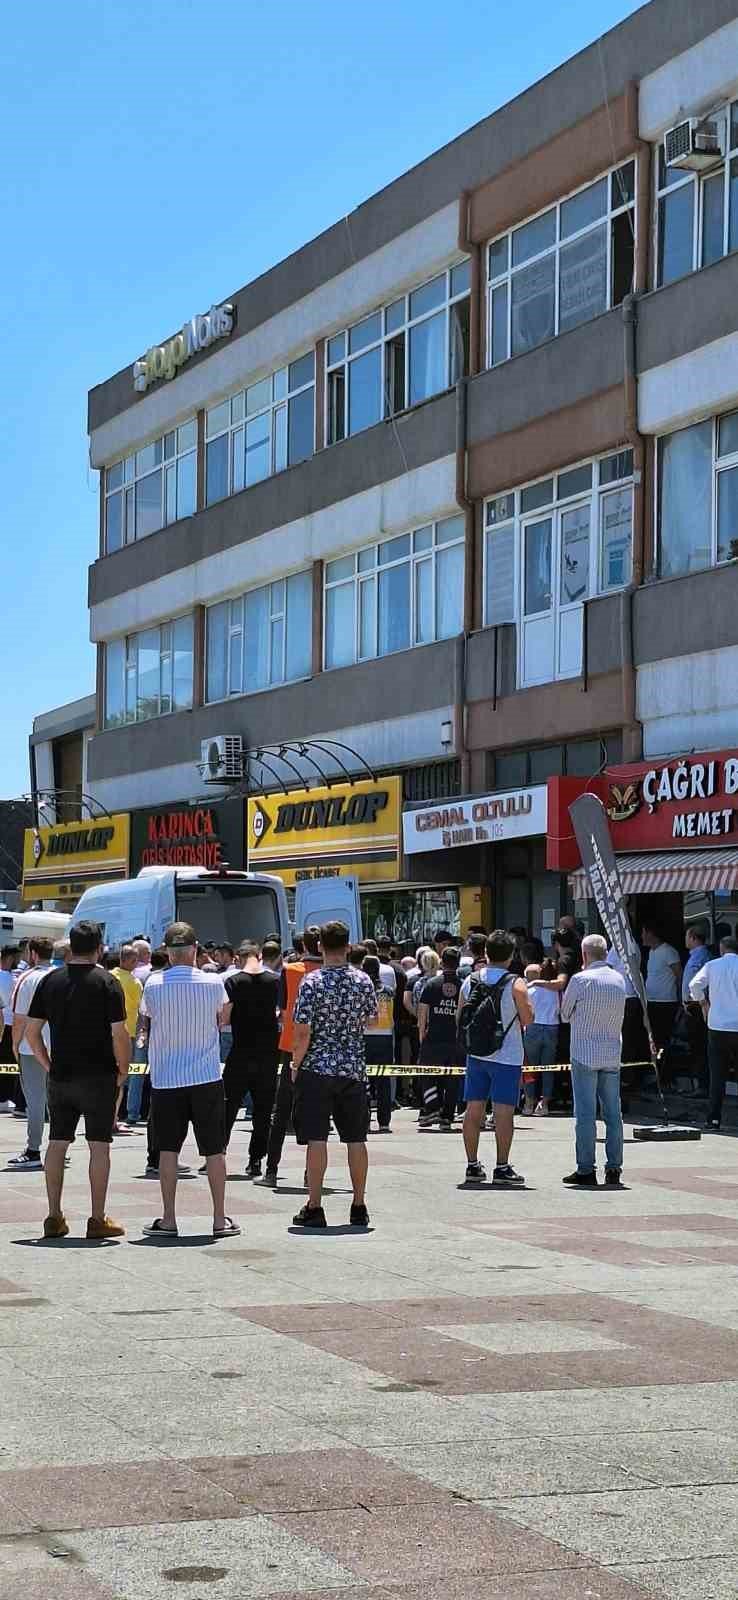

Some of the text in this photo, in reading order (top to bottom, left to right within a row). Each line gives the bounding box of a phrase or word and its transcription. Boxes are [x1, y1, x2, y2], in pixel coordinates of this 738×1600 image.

[643, 760, 715, 814] ÇAĞRI
[148, 809, 214, 841] KARINCA
[274, 791, 389, 834] DUNLOP
[415, 806, 469, 832] CEMAL
[672, 808, 732, 838] MEMET
[48, 827, 114, 856] DUNLOP
